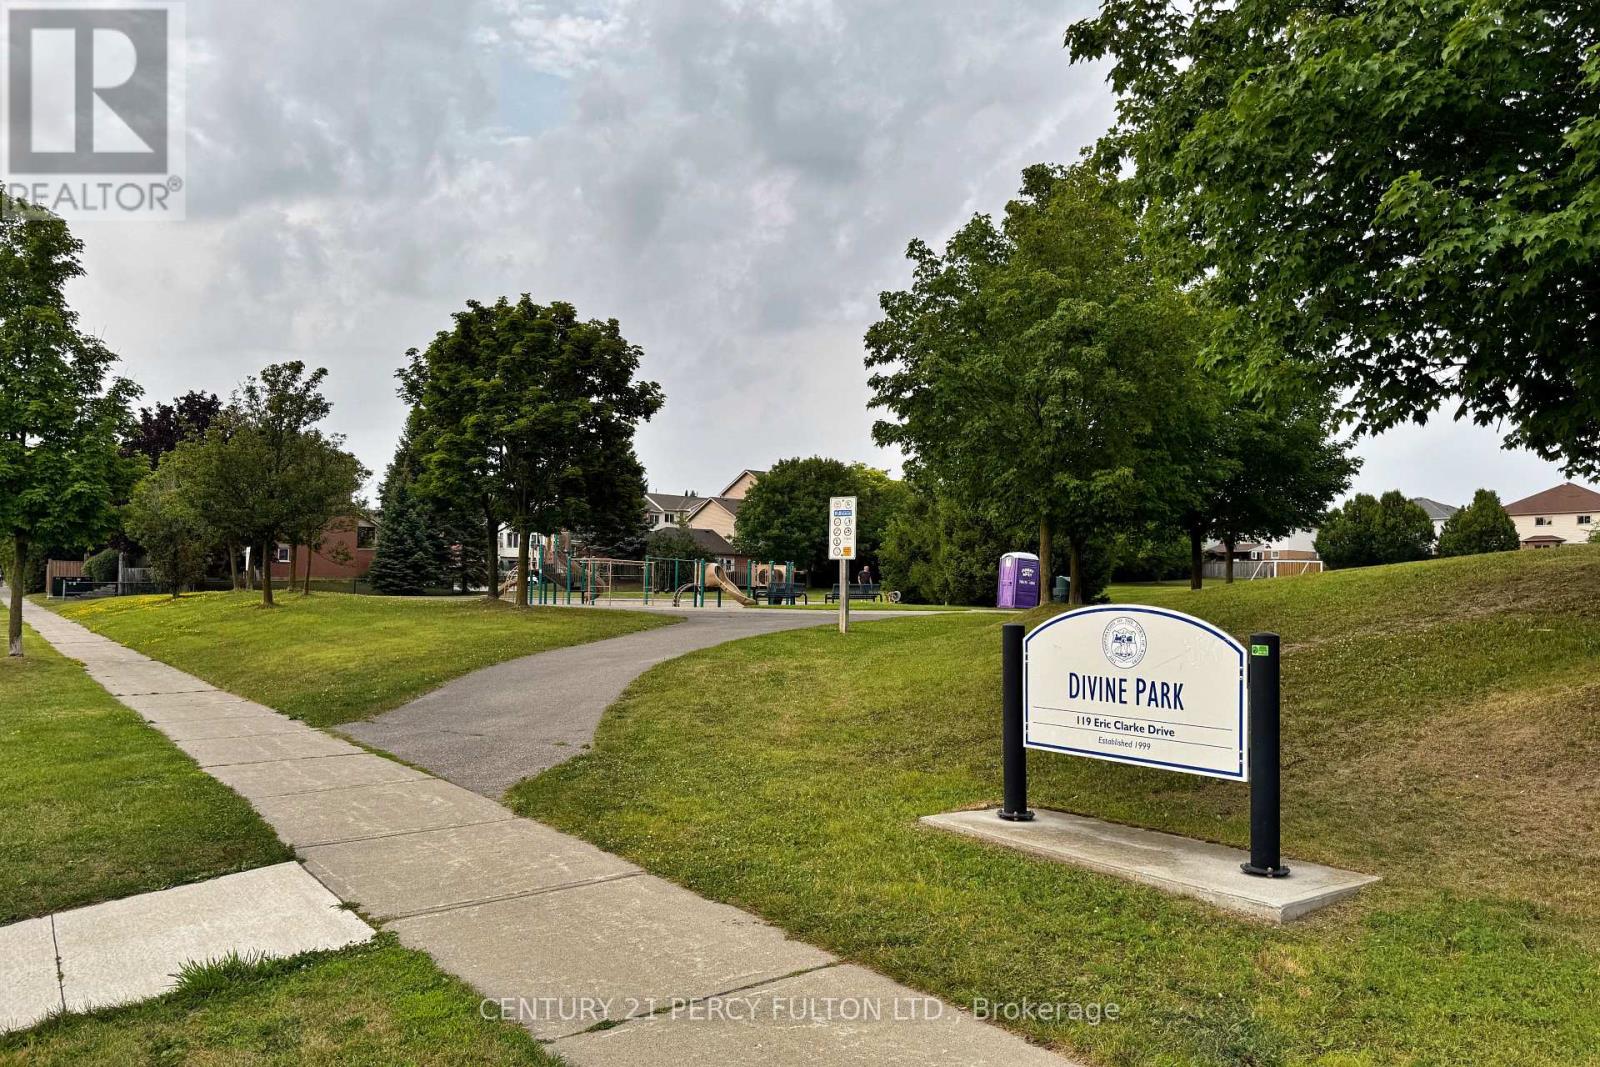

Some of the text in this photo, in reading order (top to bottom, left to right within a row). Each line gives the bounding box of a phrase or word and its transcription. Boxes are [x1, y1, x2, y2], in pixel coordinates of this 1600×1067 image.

[1069, 672, 1184, 711] DIVINE PARK
[1076, 715, 1175, 737] 119 Eric Clarke Drive
[1098, 736, 1152, 751] Established 1999
